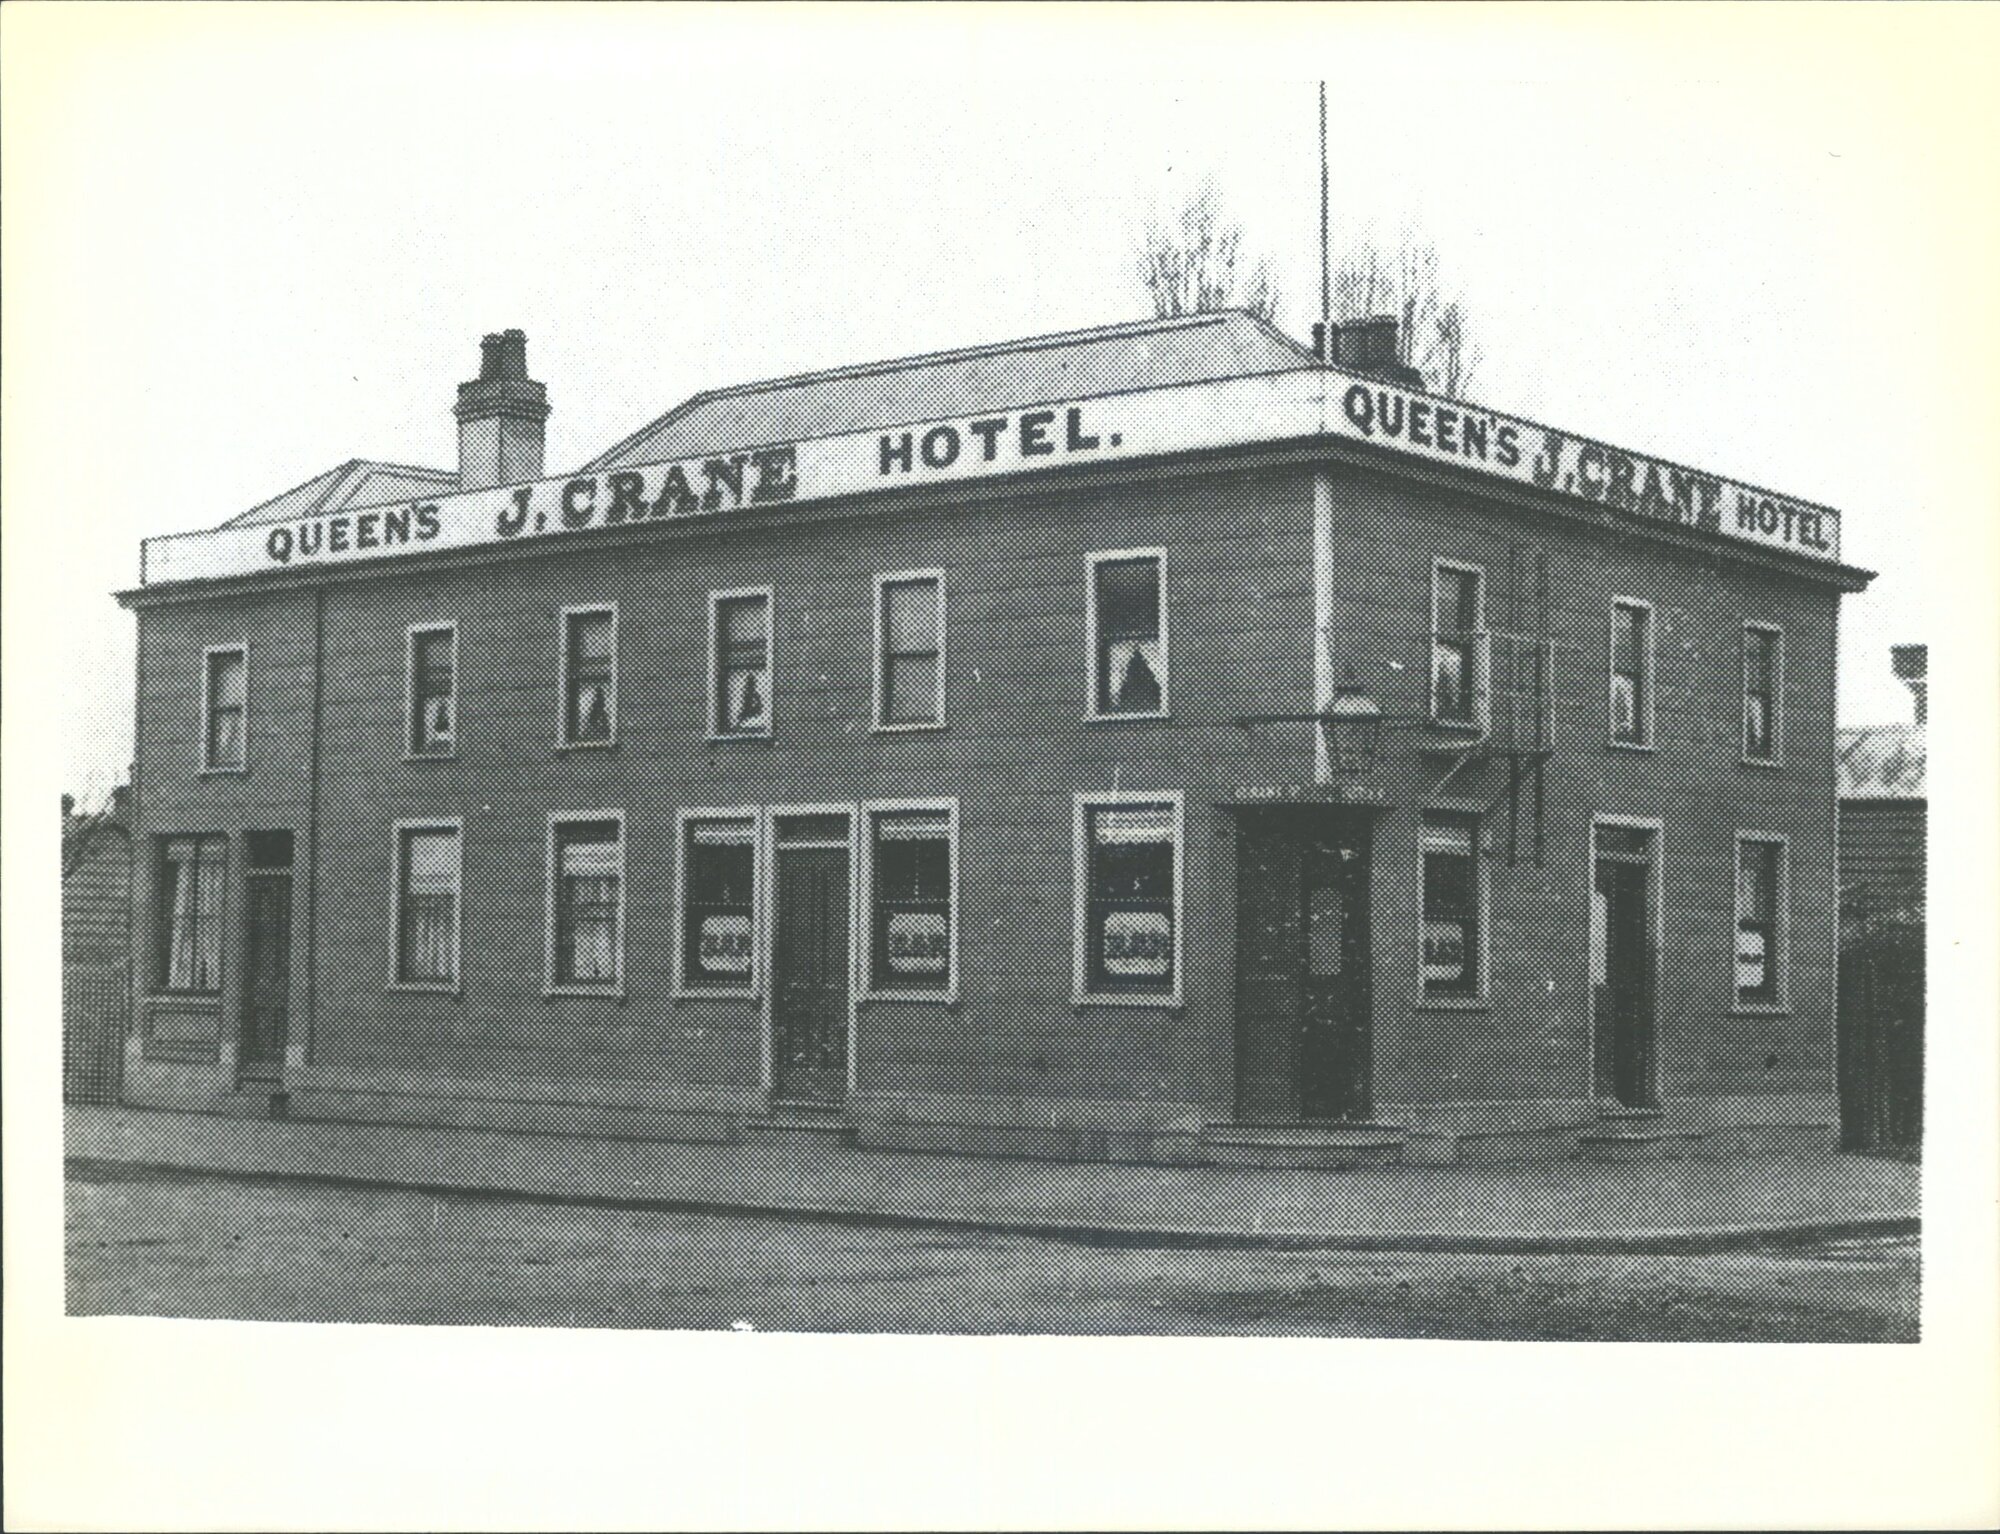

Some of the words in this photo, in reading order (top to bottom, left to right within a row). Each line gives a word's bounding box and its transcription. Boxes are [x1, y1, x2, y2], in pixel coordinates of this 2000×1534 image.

[561, 448, 797, 530] CRANE
[879, 406, 1122, 476] HOTEL.
[1343, 384, 1520, 467] QUEEN'S
[1574, 441, 1721, 532] CRANE
[1737, 491, 1831, 553] HOTEL
